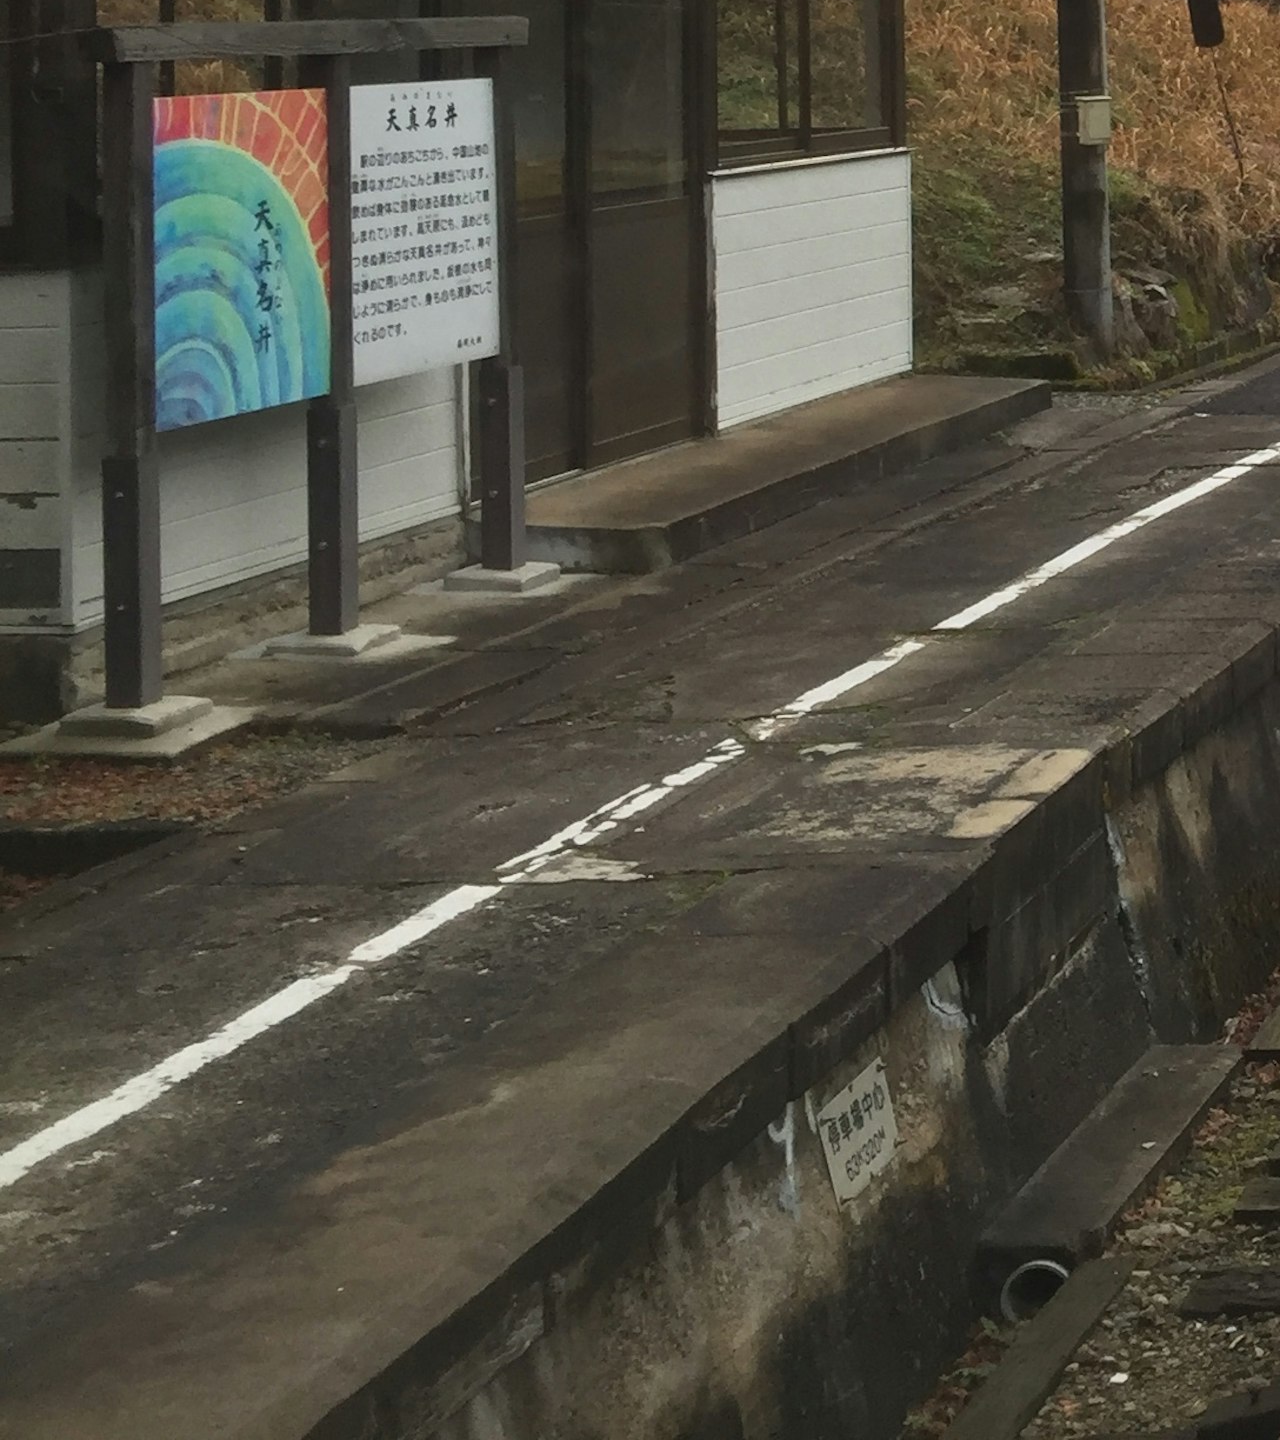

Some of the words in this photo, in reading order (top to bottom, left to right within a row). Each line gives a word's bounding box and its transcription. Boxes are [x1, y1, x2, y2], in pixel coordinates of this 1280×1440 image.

[385, 102, 459, 133] 天真名井
[253, 200, 274, 354] 天真名井
[353, 323, 408, 346] くれるのです。
[828, 1082, 886, 1157] 停車場中心
